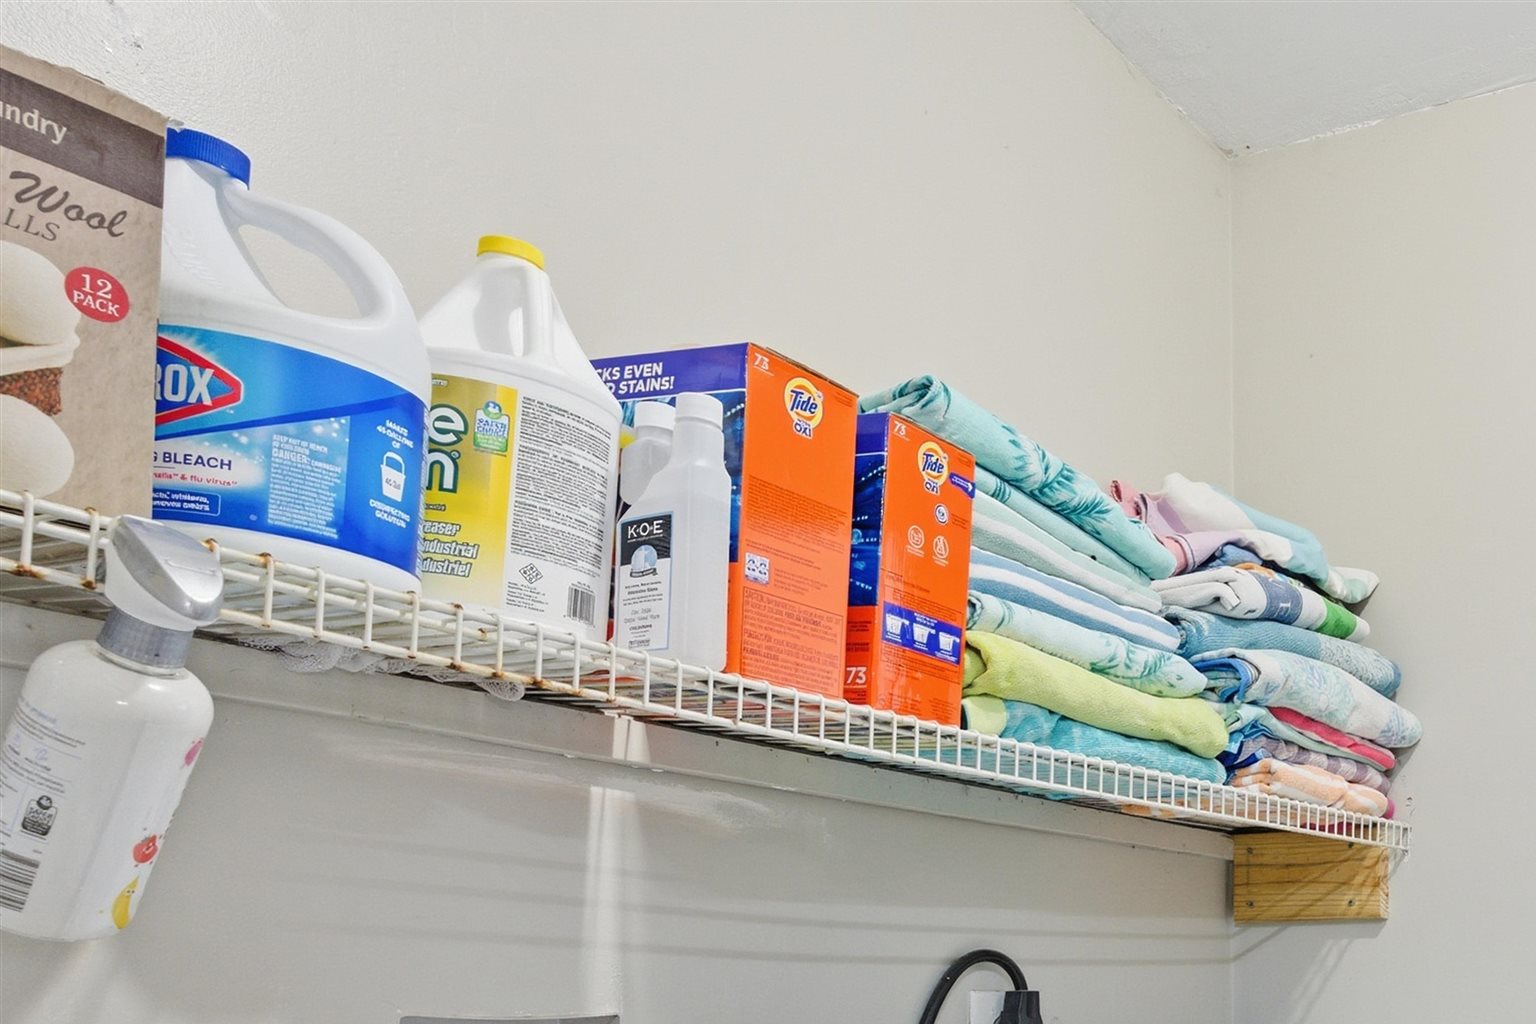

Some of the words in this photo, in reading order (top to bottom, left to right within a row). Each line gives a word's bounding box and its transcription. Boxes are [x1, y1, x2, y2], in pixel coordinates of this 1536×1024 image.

[0, 102, 67, 145] ndry
[9, 170, 128, 238] Wool
[4, 207, 60, 242] LLS
[81, 273, 112, 300] 12
[73, 289, 120, 318] PACK
[624, 362, 663, 379] EVEN
[618, 376, 675, 395] STAINS!
[790, 389, 818, 415] Tide
[162, 451, 232, 471] BLEACH
[922, 452, 944, 474] Tide
[846, 666, 867, 685] 73
